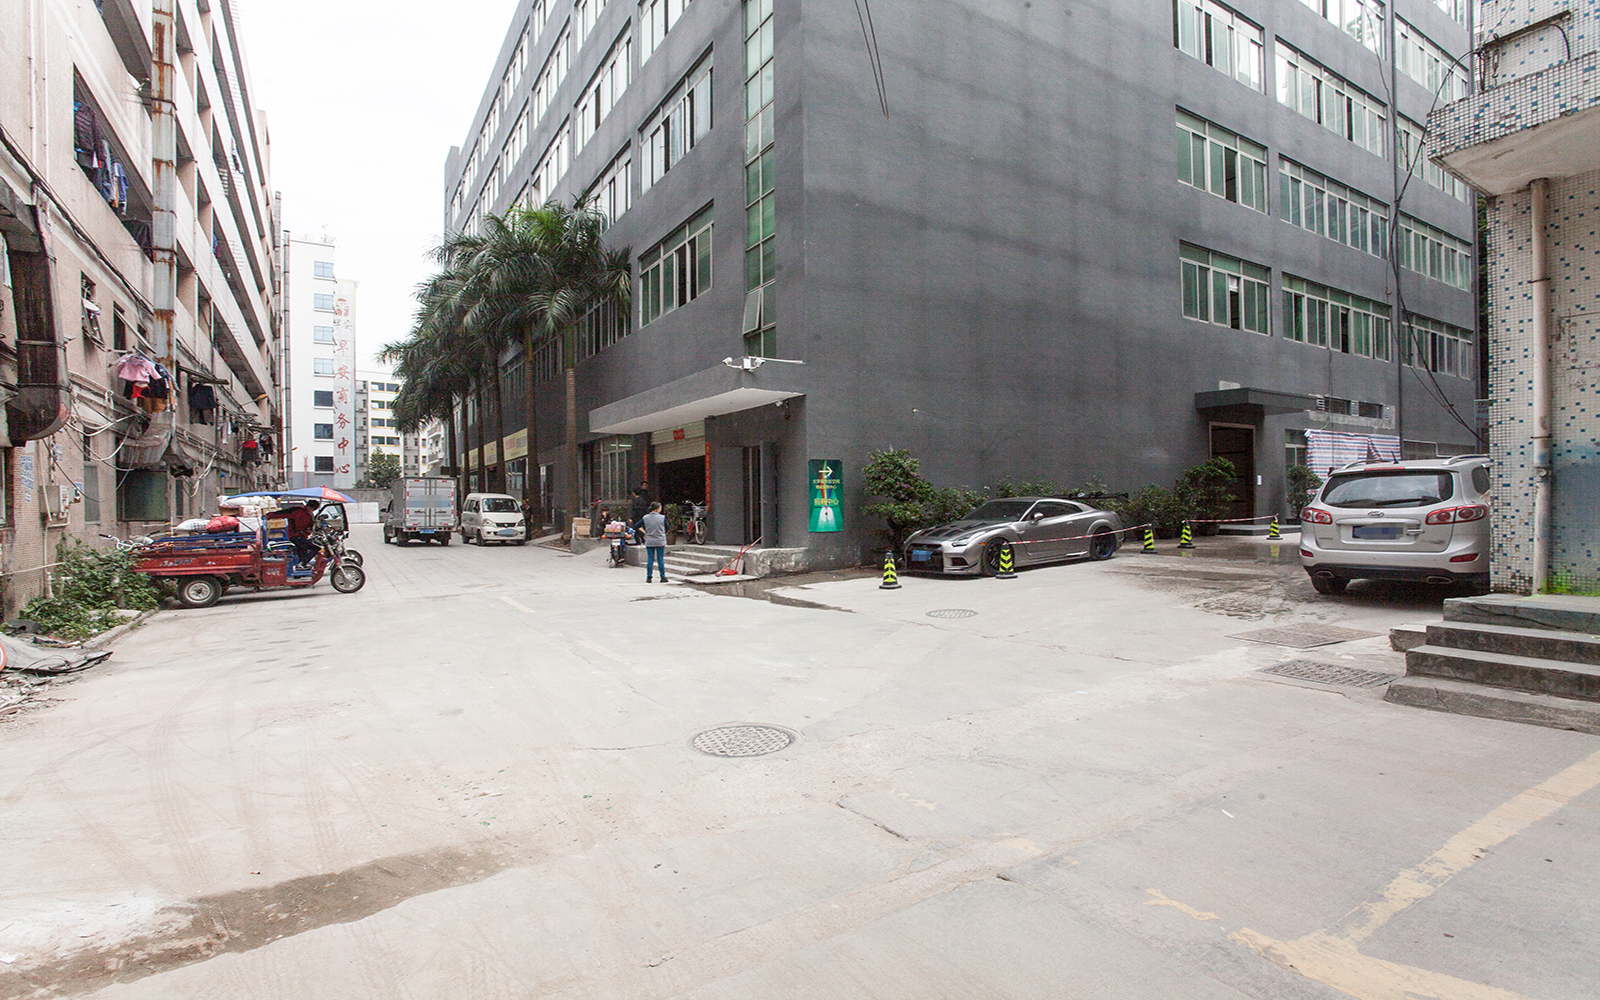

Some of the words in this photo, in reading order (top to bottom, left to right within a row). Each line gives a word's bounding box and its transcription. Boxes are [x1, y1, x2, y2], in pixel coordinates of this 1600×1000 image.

[335, 339, 351, 475] 早安商务中心
